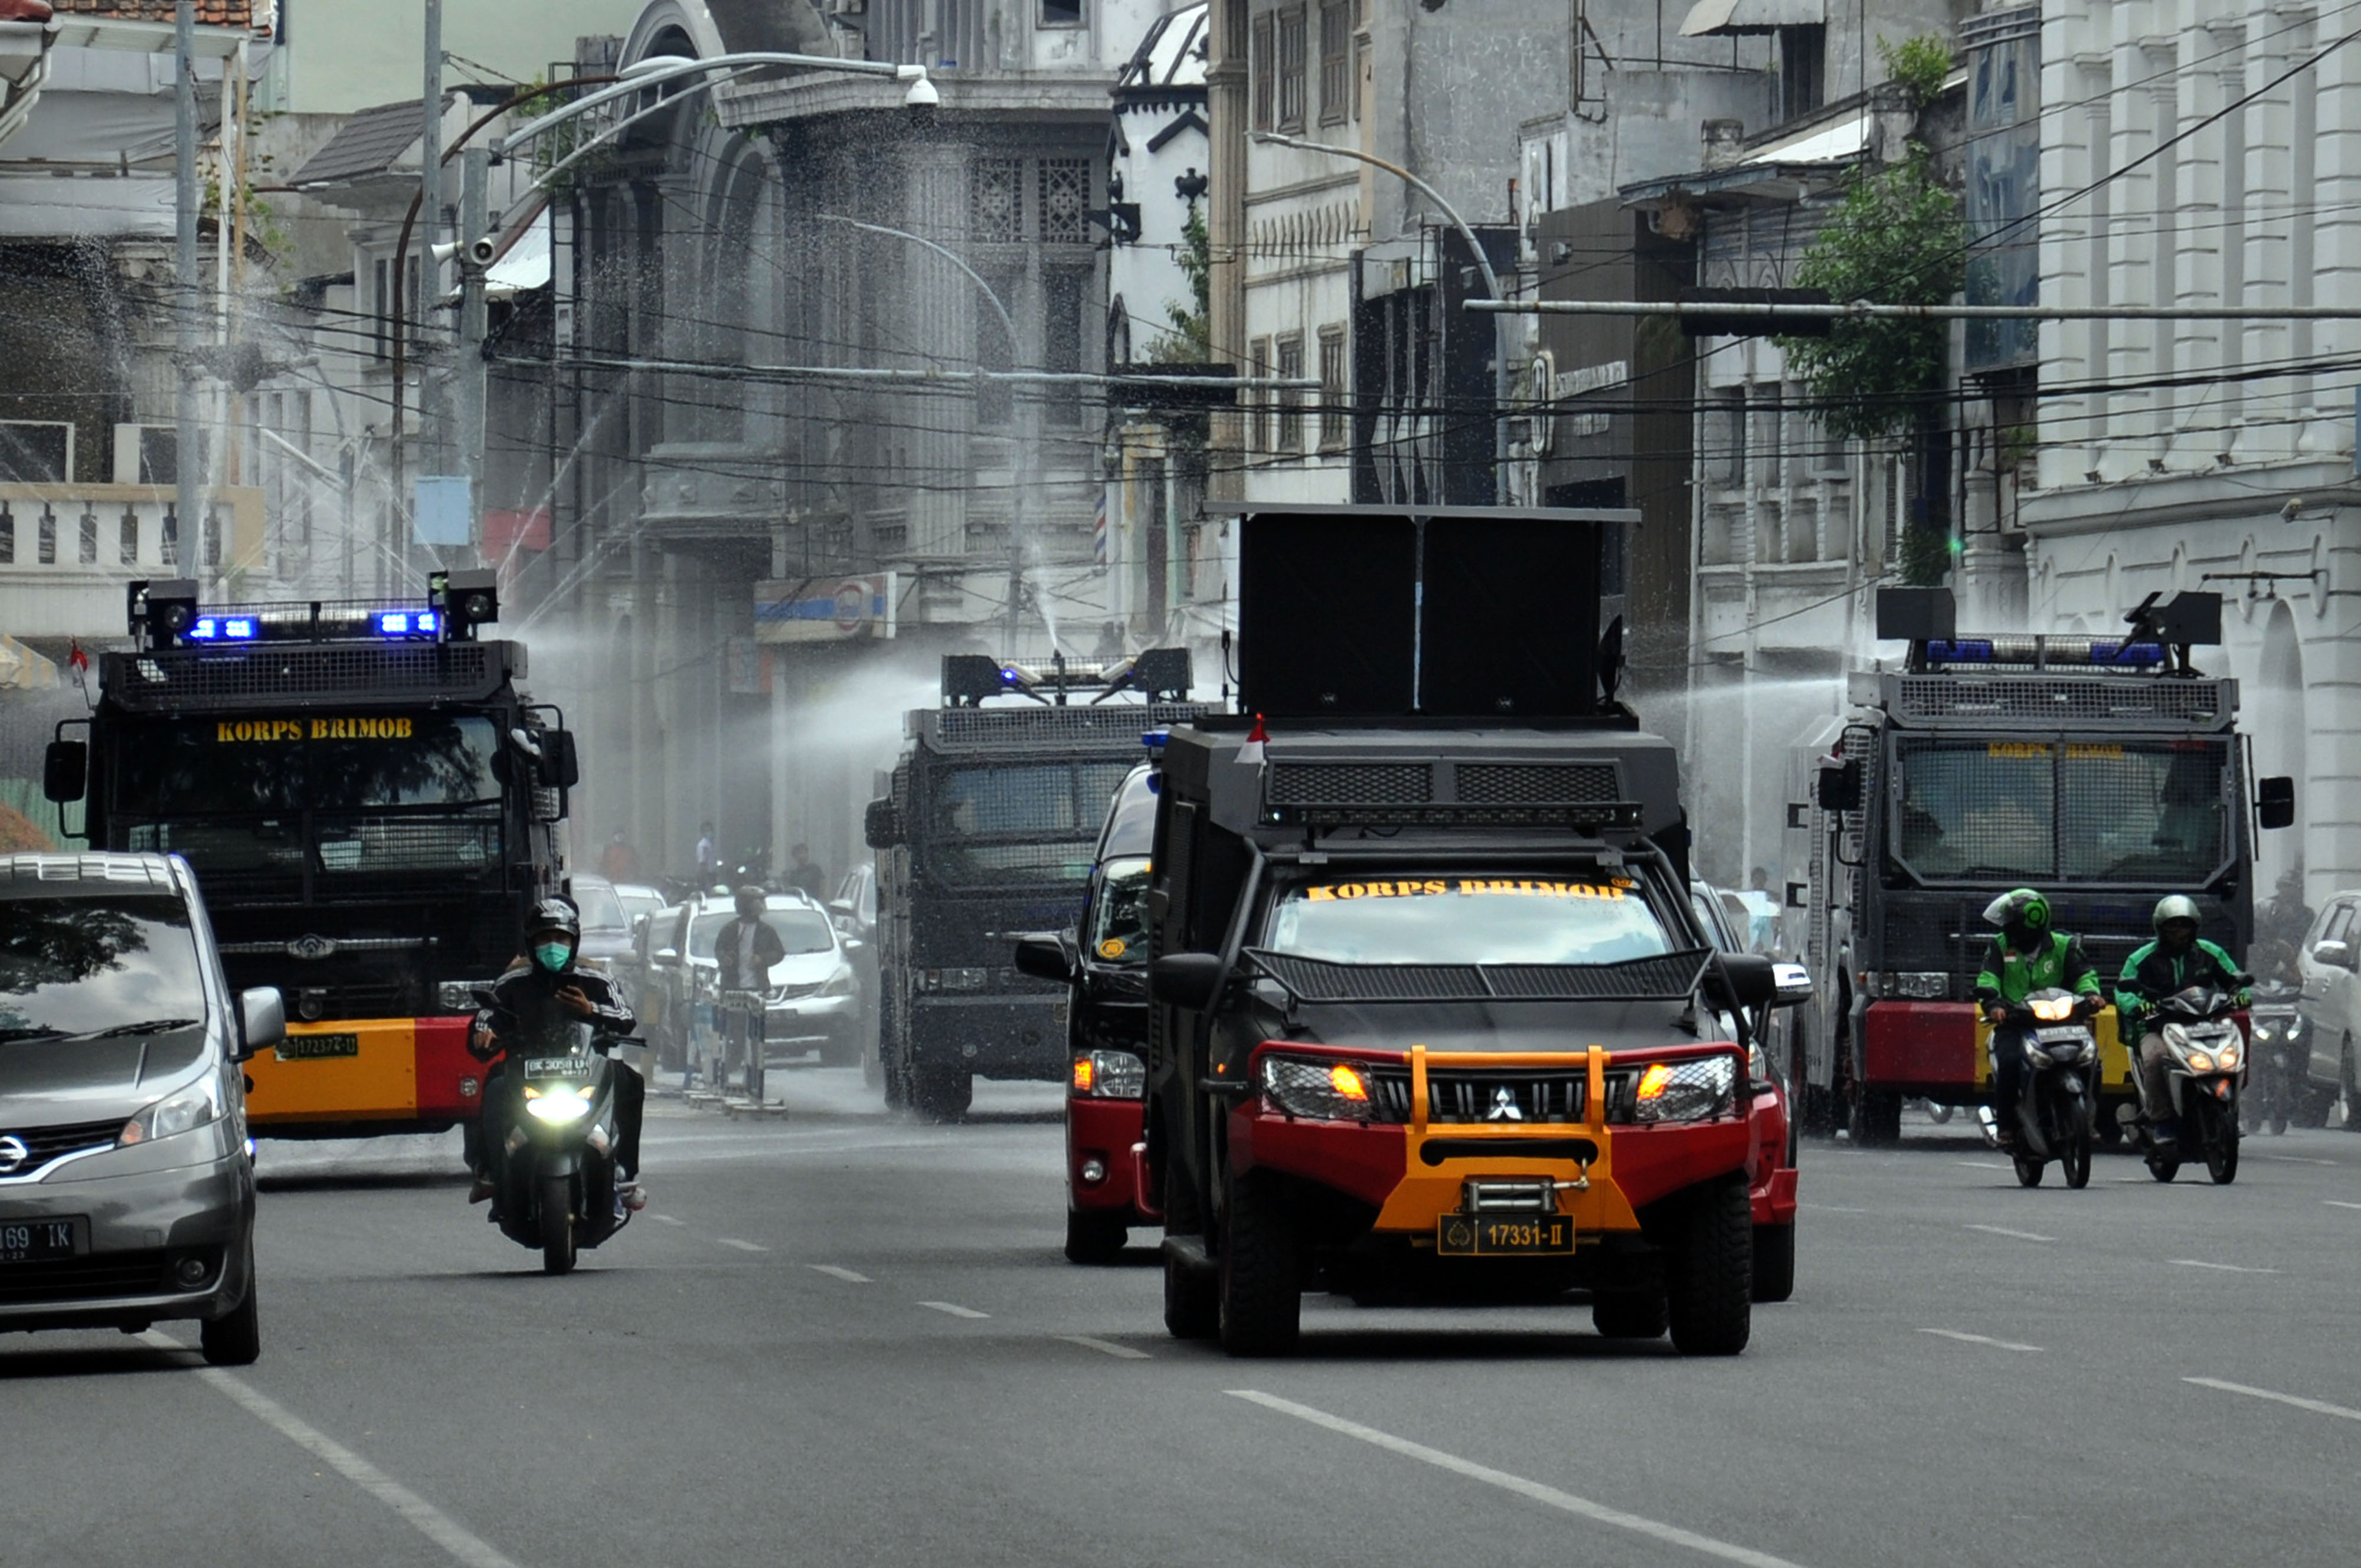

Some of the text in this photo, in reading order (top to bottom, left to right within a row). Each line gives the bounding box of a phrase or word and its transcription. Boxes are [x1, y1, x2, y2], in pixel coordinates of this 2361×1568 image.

[217, 718, 412, 742] KORPS BRIMOB
[1307, 881, 1446, 902] KORPS
[1460, 880, 1624, 901] BRIMOB
[48, 1223, 69, 1247] IK
[1488, 1225, 1562, 1246] 17331-II
